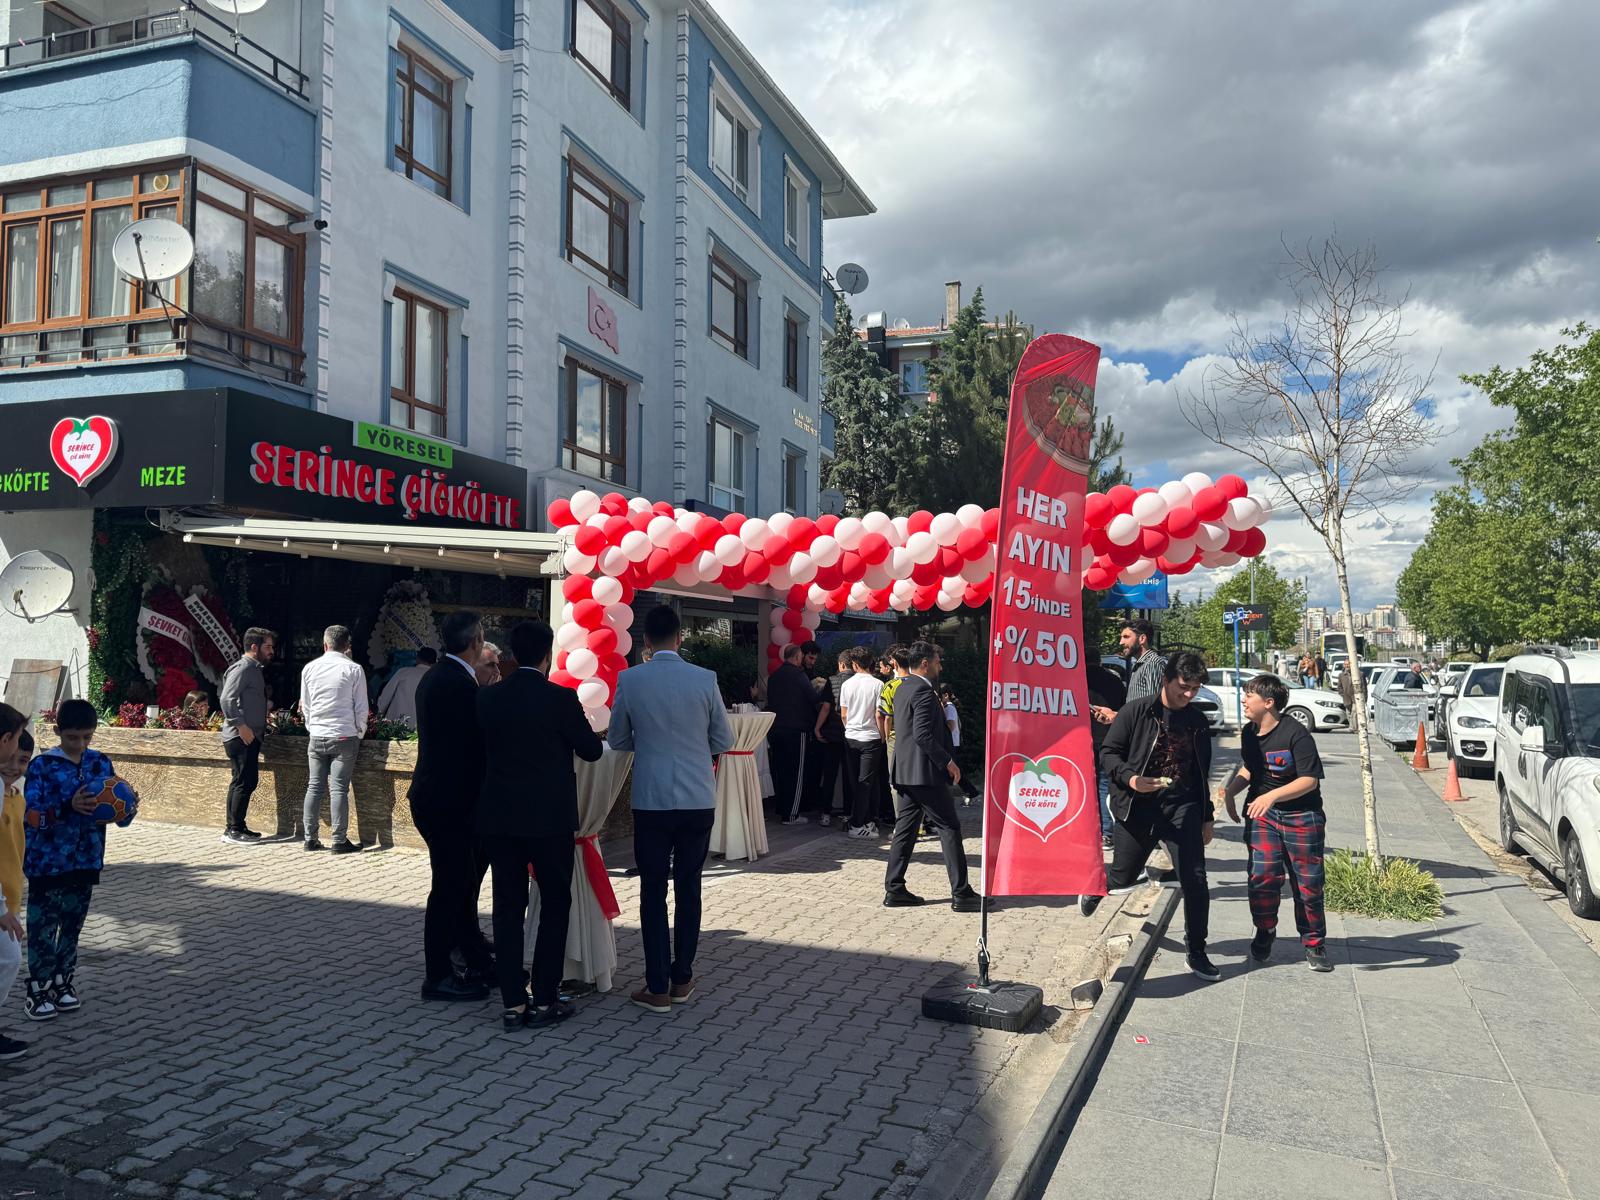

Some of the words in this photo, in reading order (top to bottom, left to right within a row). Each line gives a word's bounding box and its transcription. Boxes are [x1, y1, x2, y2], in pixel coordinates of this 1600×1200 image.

[67, 442, 95, 453] SERİNCE
[367, 429, 446, 461] YÖRESEL
[140, 466, 186, 487] MEZE
[250, 441, 396, 505] SERİNCE
[401, 468, 520, 529] ÇİĞKÖFTE
[1016, 486, 1067, 529] HER
[1008, 531, 1071, 574] AYIN
[991, 681, 1078, 716] BEDAVA
[1019, 786, 1061, 798] SERİNCE
[1024, 799, 1037, 809] ÇİĞ
[1038, 799, 1058, 809] KÖFTE
